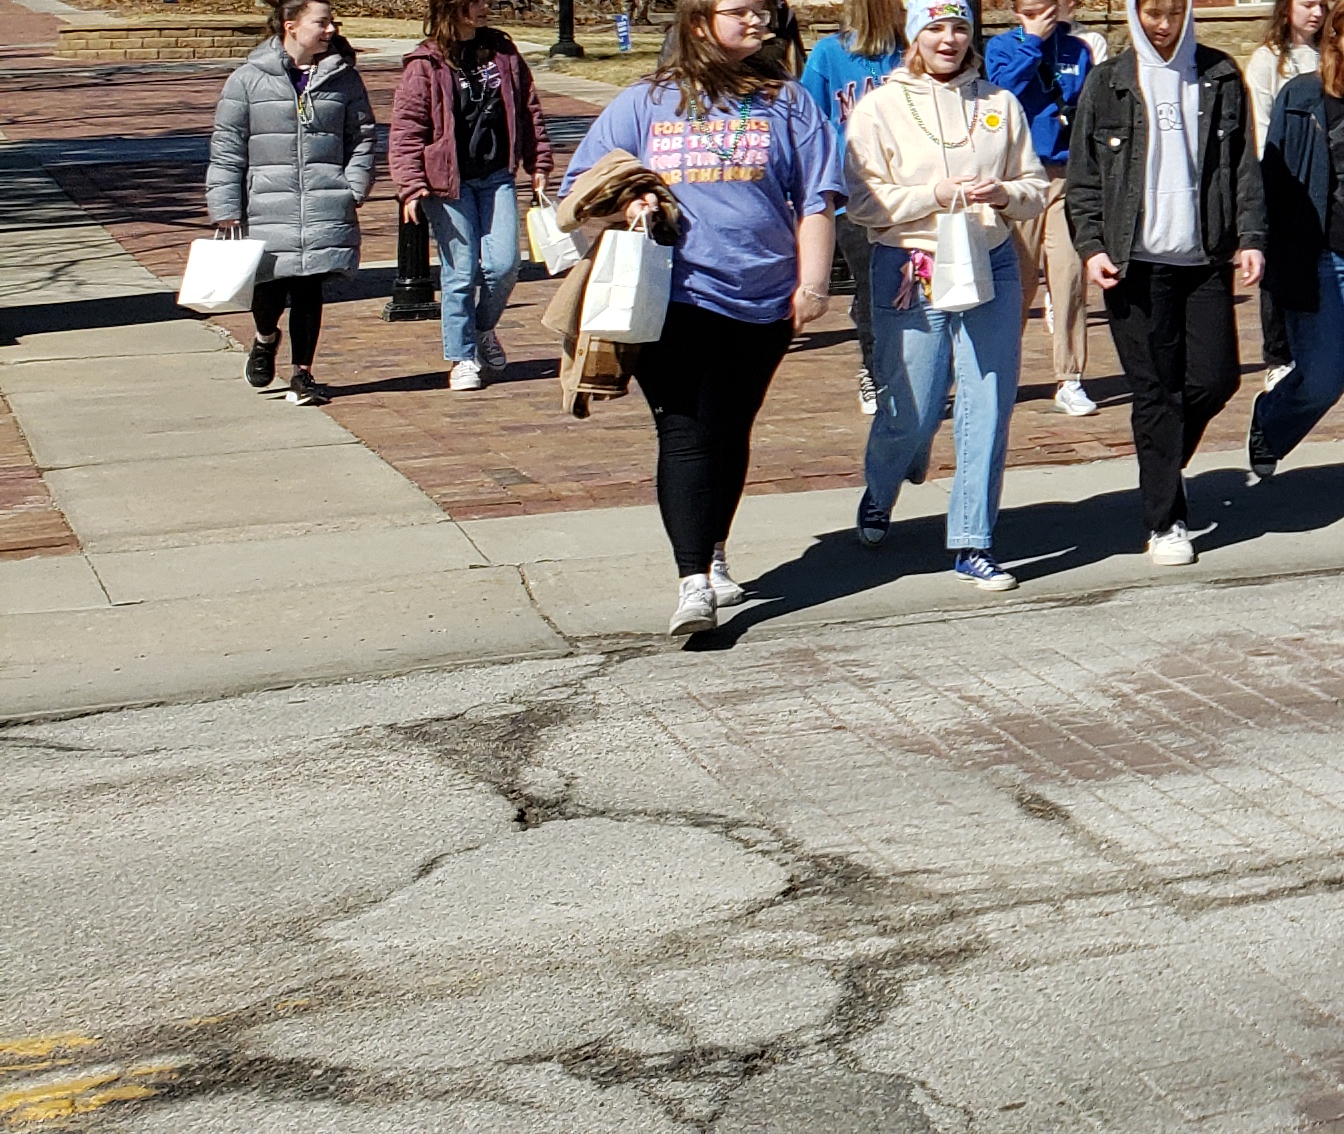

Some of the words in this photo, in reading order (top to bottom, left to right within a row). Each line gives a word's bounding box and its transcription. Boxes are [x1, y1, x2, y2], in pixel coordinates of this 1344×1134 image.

[653, 122, 685, 136] FOR
[727, 118, 770, 133] KDS
[652, 136, 683, 152] FOR
